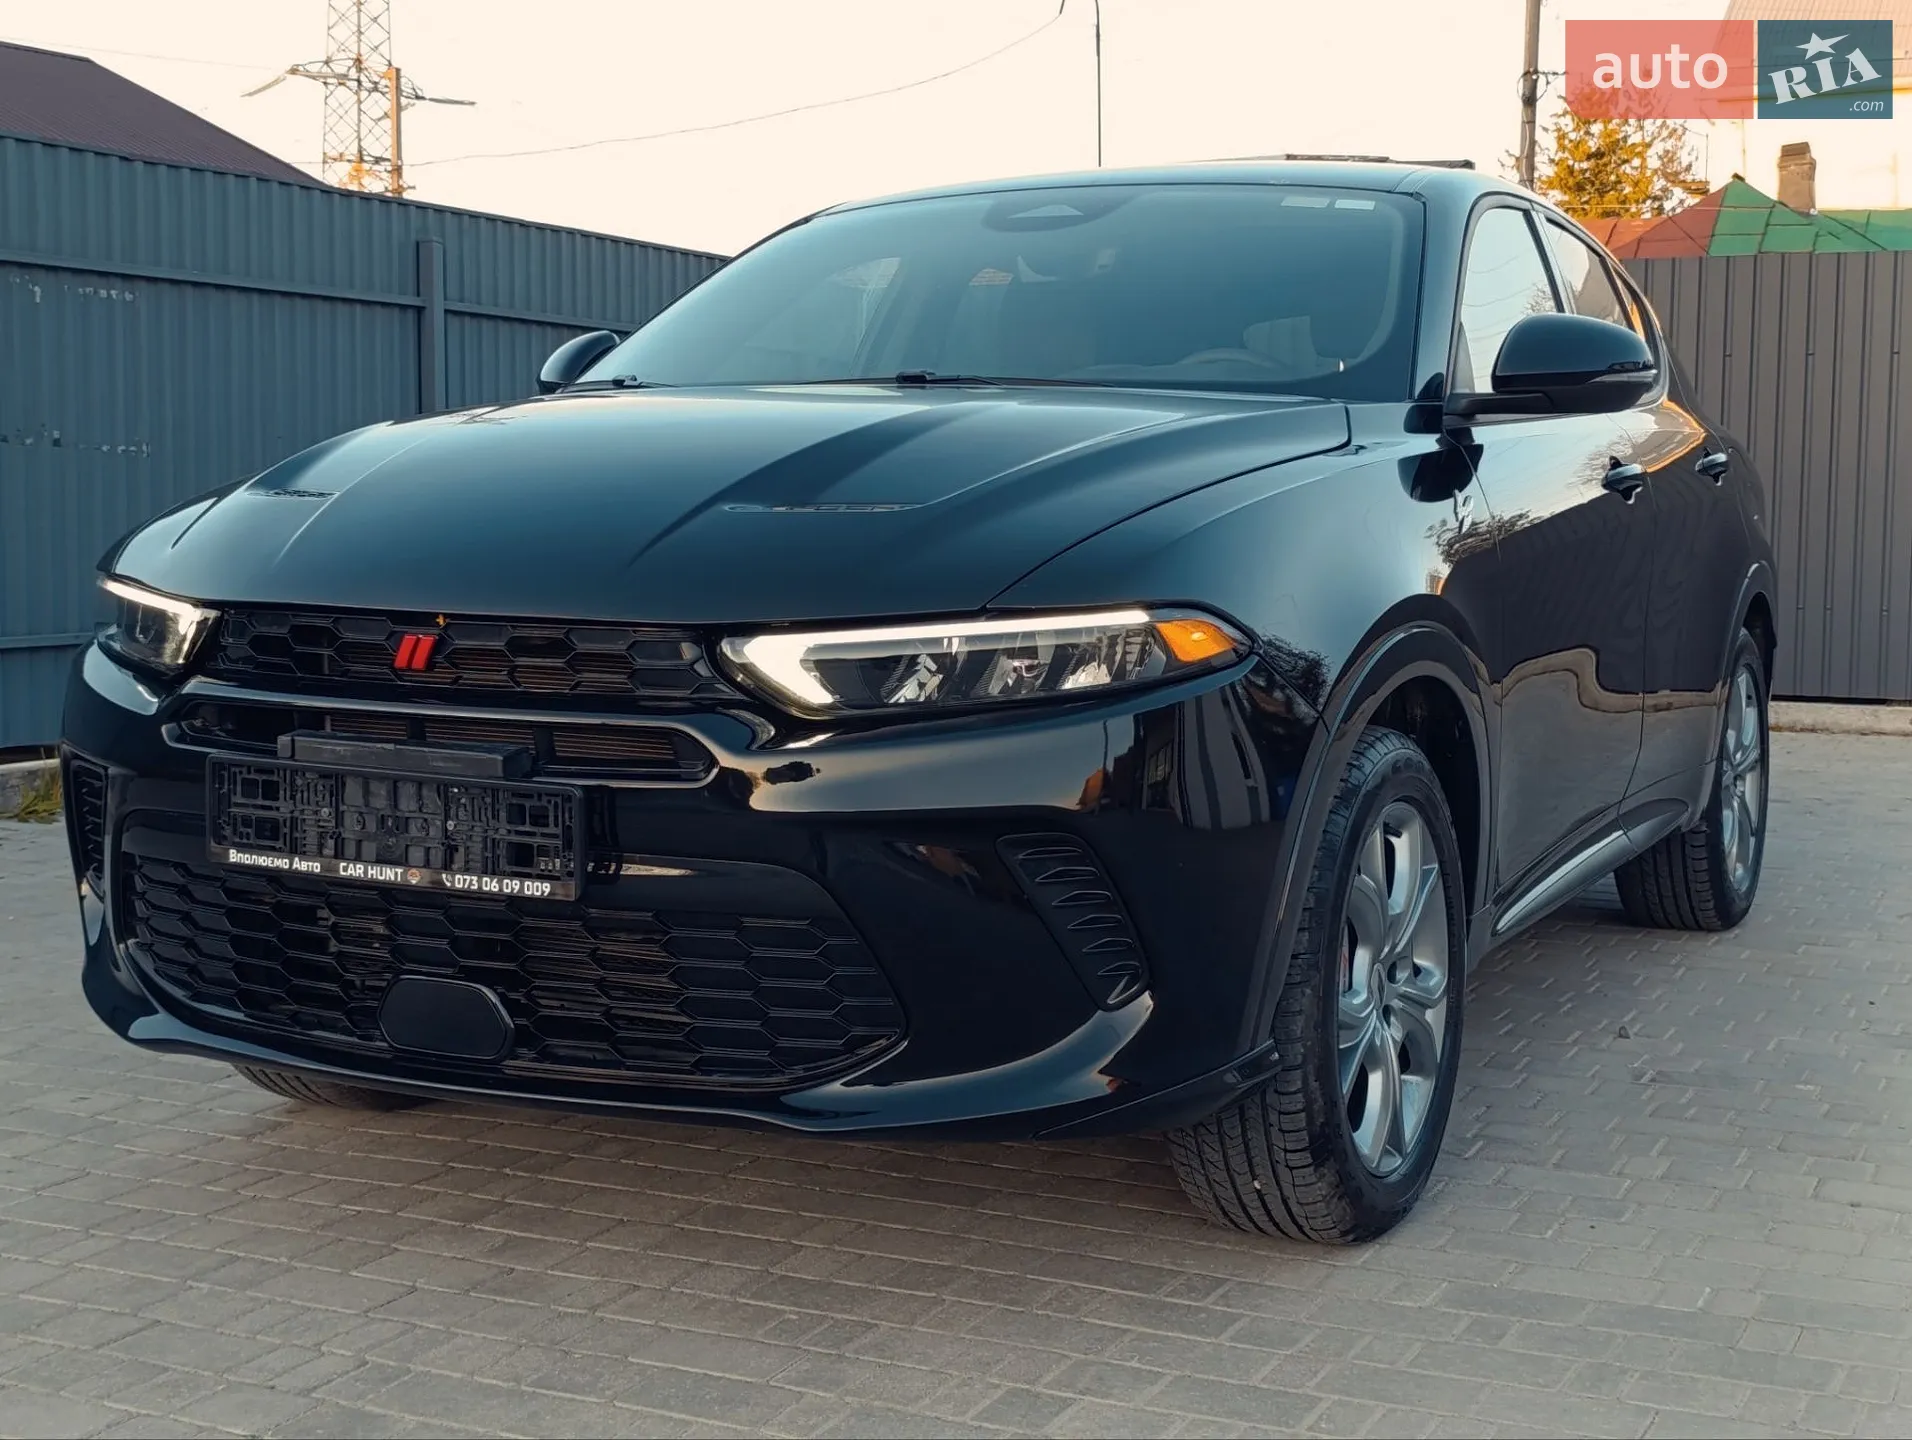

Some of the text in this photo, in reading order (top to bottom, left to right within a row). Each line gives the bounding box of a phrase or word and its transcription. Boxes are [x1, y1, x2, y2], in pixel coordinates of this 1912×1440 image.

[228, 848, 551, 896] Вполюємо Авто CAR HUNT 073 06 09 009
